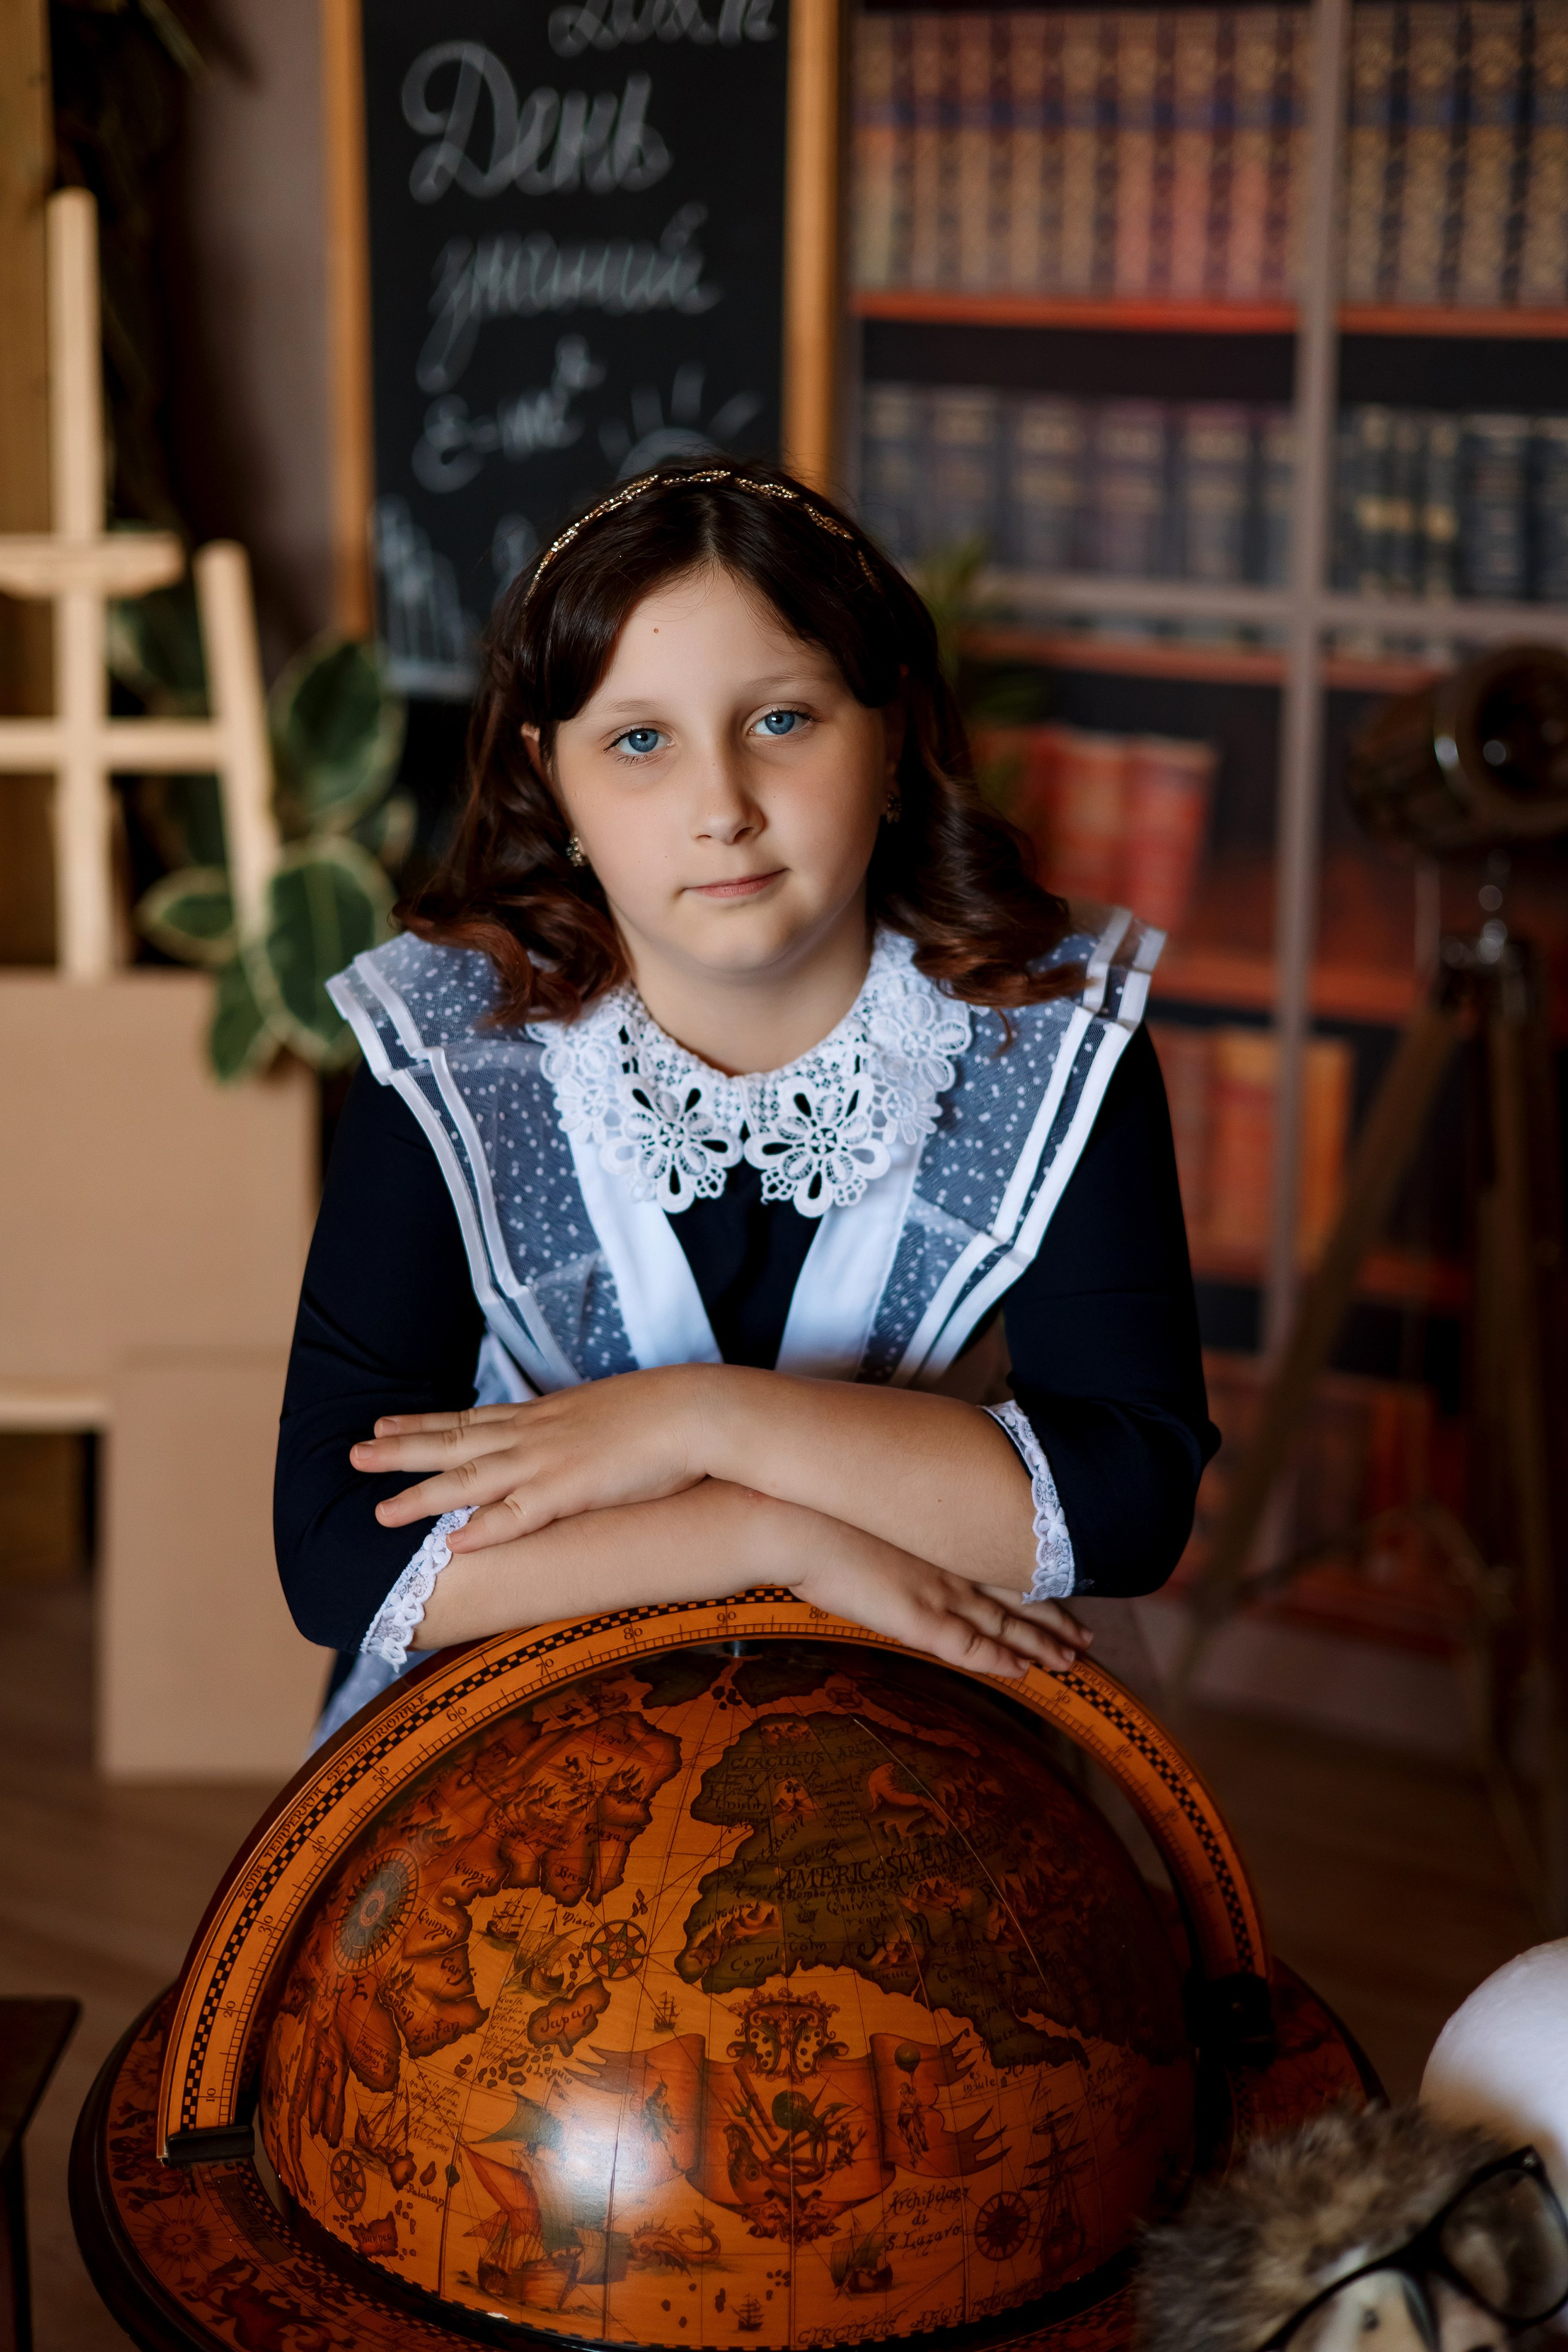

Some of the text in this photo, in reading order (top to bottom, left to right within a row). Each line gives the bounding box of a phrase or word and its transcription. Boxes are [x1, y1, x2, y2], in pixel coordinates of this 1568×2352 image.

[401, 39, 674, 205] День
[717, 1611, 736, 1626] 90
[809, 1607, 828, 1620] 80
[623, 1626, 643, 1640] 80
[536, 1659, 554, 1676] 70
[1052, 1689, 1070, 1705] 50
[446, 1706, 467, 1722] 60
[372, 1766, 389, 1786] 50
[238, 1694, 428, 1900] ZONA TEMPERATA SETTENTRIONALE
[312, 1835, 326, 1854] 40
[258, 1915, 274, 1936] 30
[562, 1910, 596, 1929] Miaco
[223, 2000, 236, 2018] 20
[540, 2004, 593, 2035] Japan
[206, 2088, 216, 2102] 10
